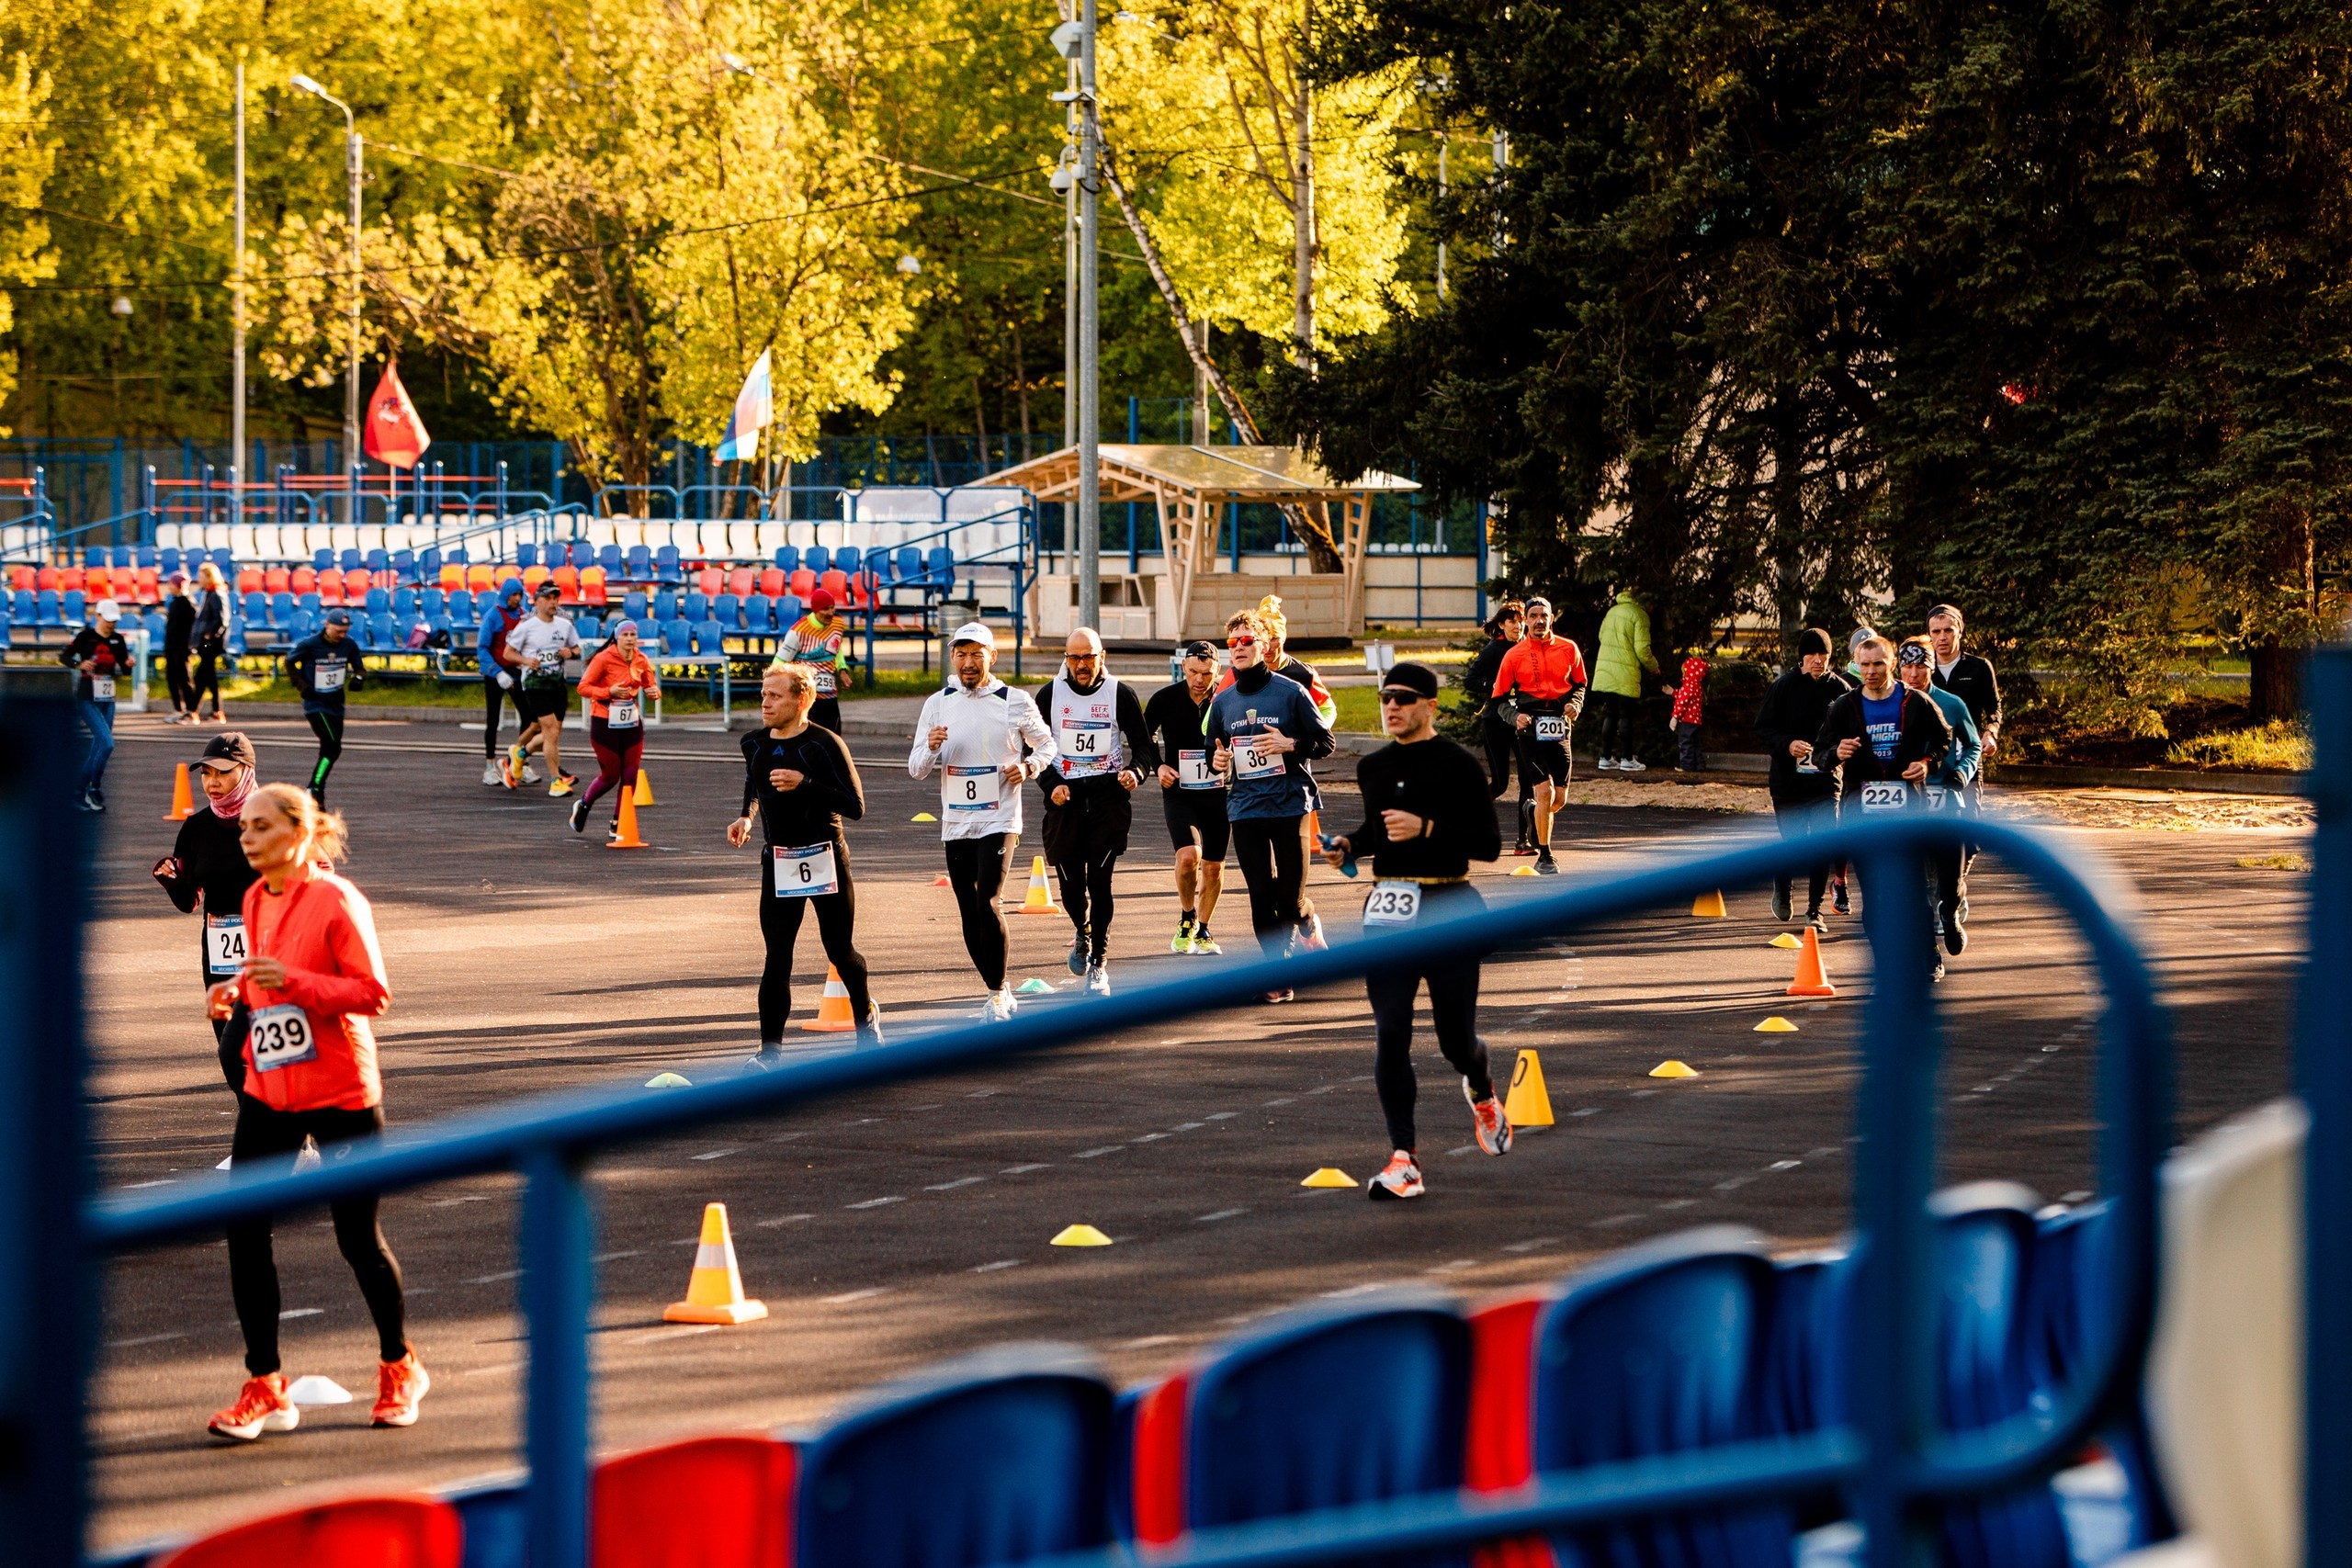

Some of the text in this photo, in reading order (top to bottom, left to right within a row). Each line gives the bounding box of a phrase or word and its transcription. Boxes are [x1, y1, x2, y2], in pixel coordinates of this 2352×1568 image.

[538, 653, 560, 662] 206
[325, 674, 337, 685] 32
[817, 677, 833, 688] 259
[620, 708, 632, 721] 67
[1539, 722, 1563, 734] 201
[1076, 734, 1095, 752] 54
[1871, 731, 1902, 742] NIGHT
[1196, 762, 1210, 779] 17
[967, 780, 977, 800] 8
[1865, 789, 1903, 805] 224
[799, 862, 811, 884] 6
[1370, 892, 1414, 916] 233
[220, 932, 245, 959] 24
[255, 1018, 305, 1054] 239
